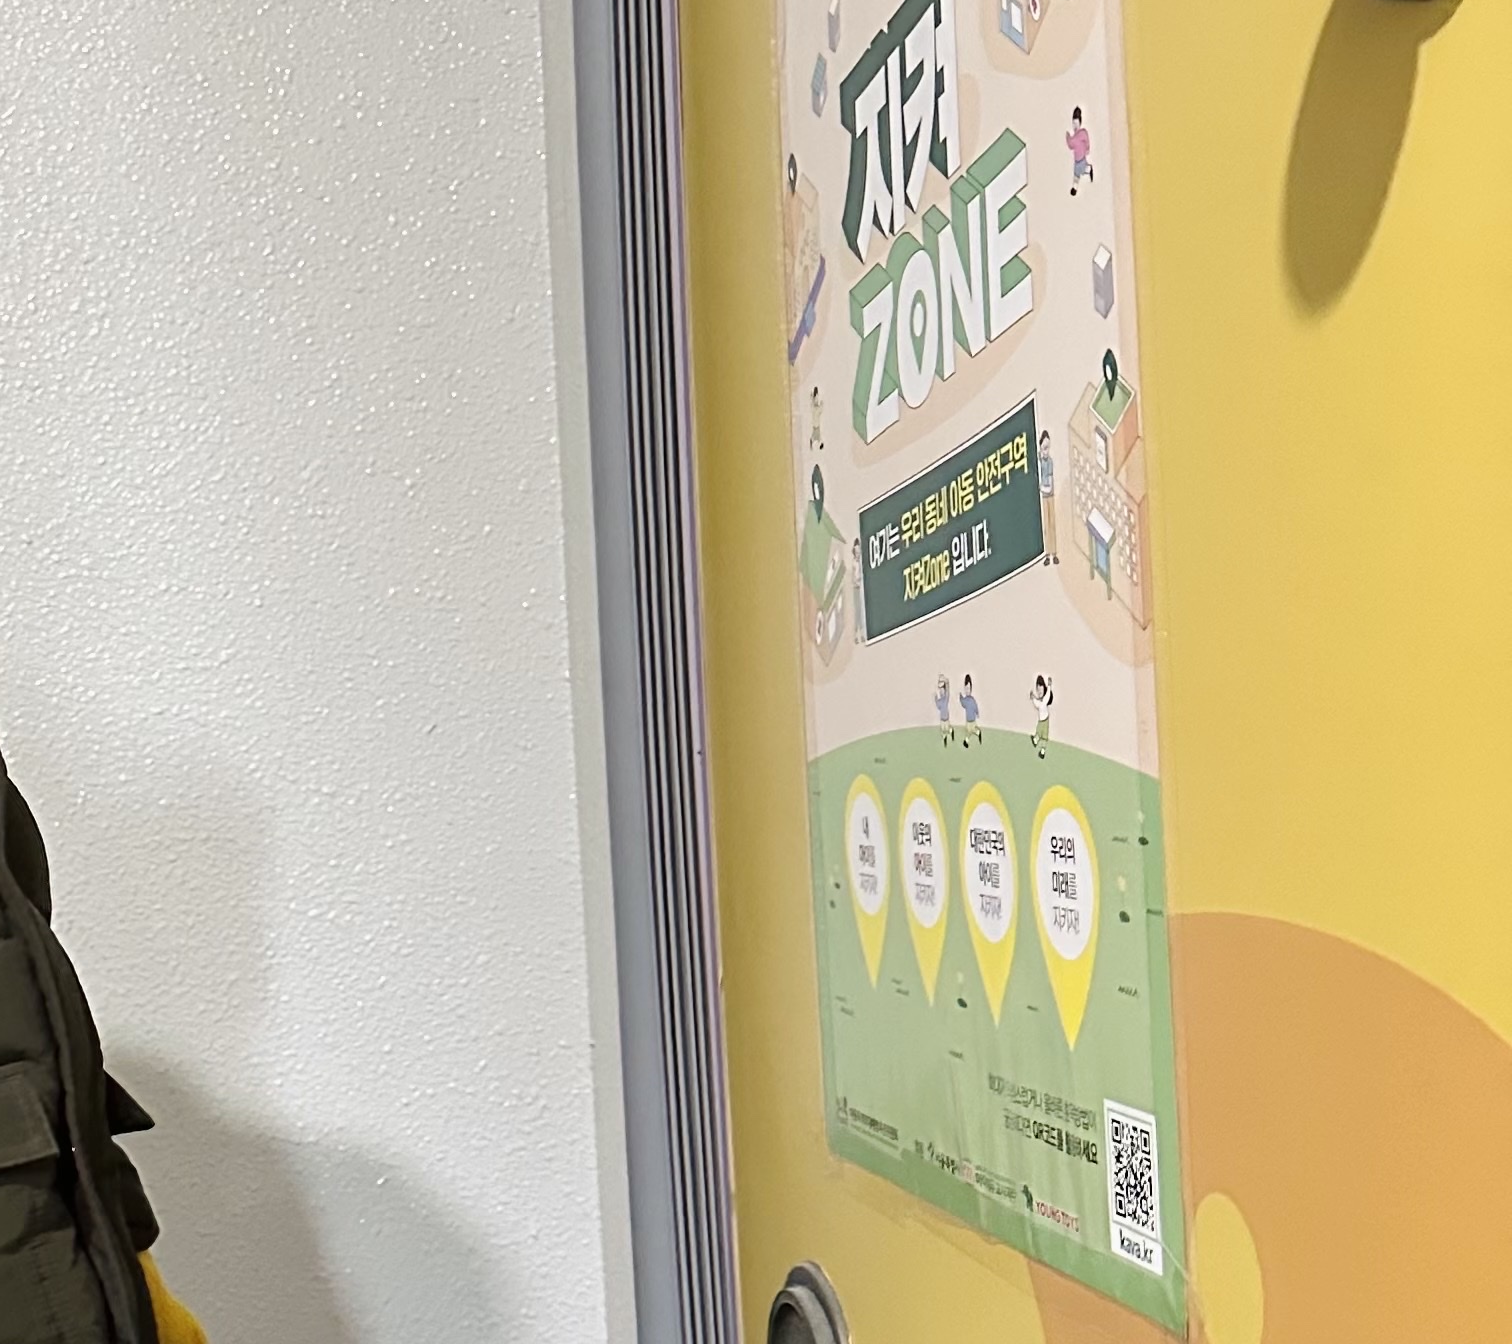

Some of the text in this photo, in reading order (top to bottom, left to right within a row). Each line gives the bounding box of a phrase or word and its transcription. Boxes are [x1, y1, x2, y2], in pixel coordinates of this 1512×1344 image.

[852, 131, 1033, 444] ZONE
[868, 432, 1029, 569] 여기는 우리 동네 아동 안전구역
[903, 519, 992, 601] 지켜Zone 입니다.
[970, 828, 1006, 857] 대한민국의
[1050, 835, 1076, 864] 우리의
[1052, 871, 1077, 901] 미래를
[1119, 1229, 1154, 1264] kava.kr
